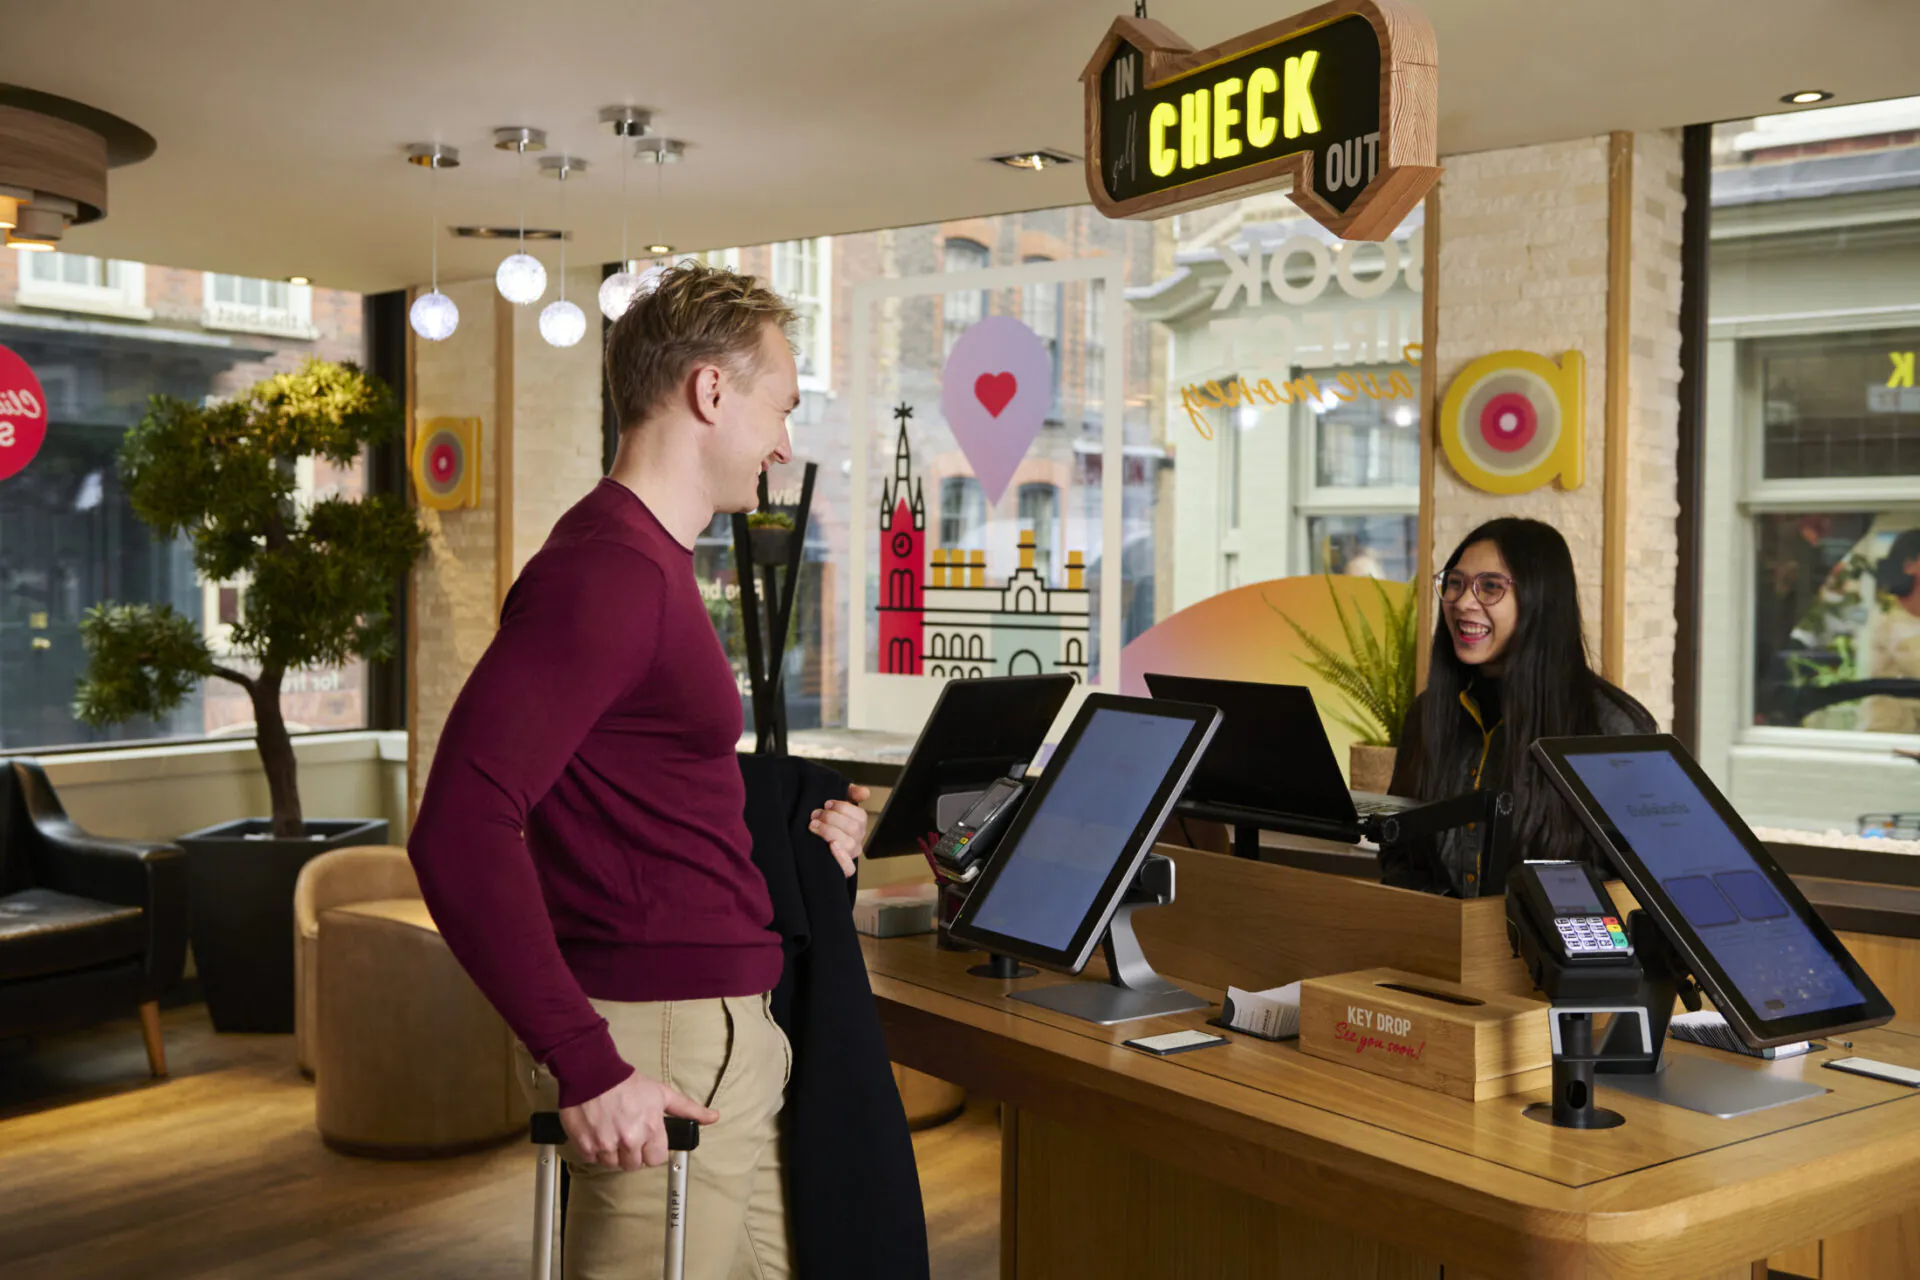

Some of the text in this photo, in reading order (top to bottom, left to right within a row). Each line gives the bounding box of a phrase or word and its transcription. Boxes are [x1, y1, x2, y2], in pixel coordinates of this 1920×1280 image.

[1114, 53, 1136, 102] IN
[1148, 50, 1322, 178] CHECK
[1325, 131, 1381, 193] OUT
[1335, 1021, 1426, 1060] See you soon!
[1347, 1004, 1412, 1038] KEY DROP
[670, 1190, 680, 1229] TRIPP
